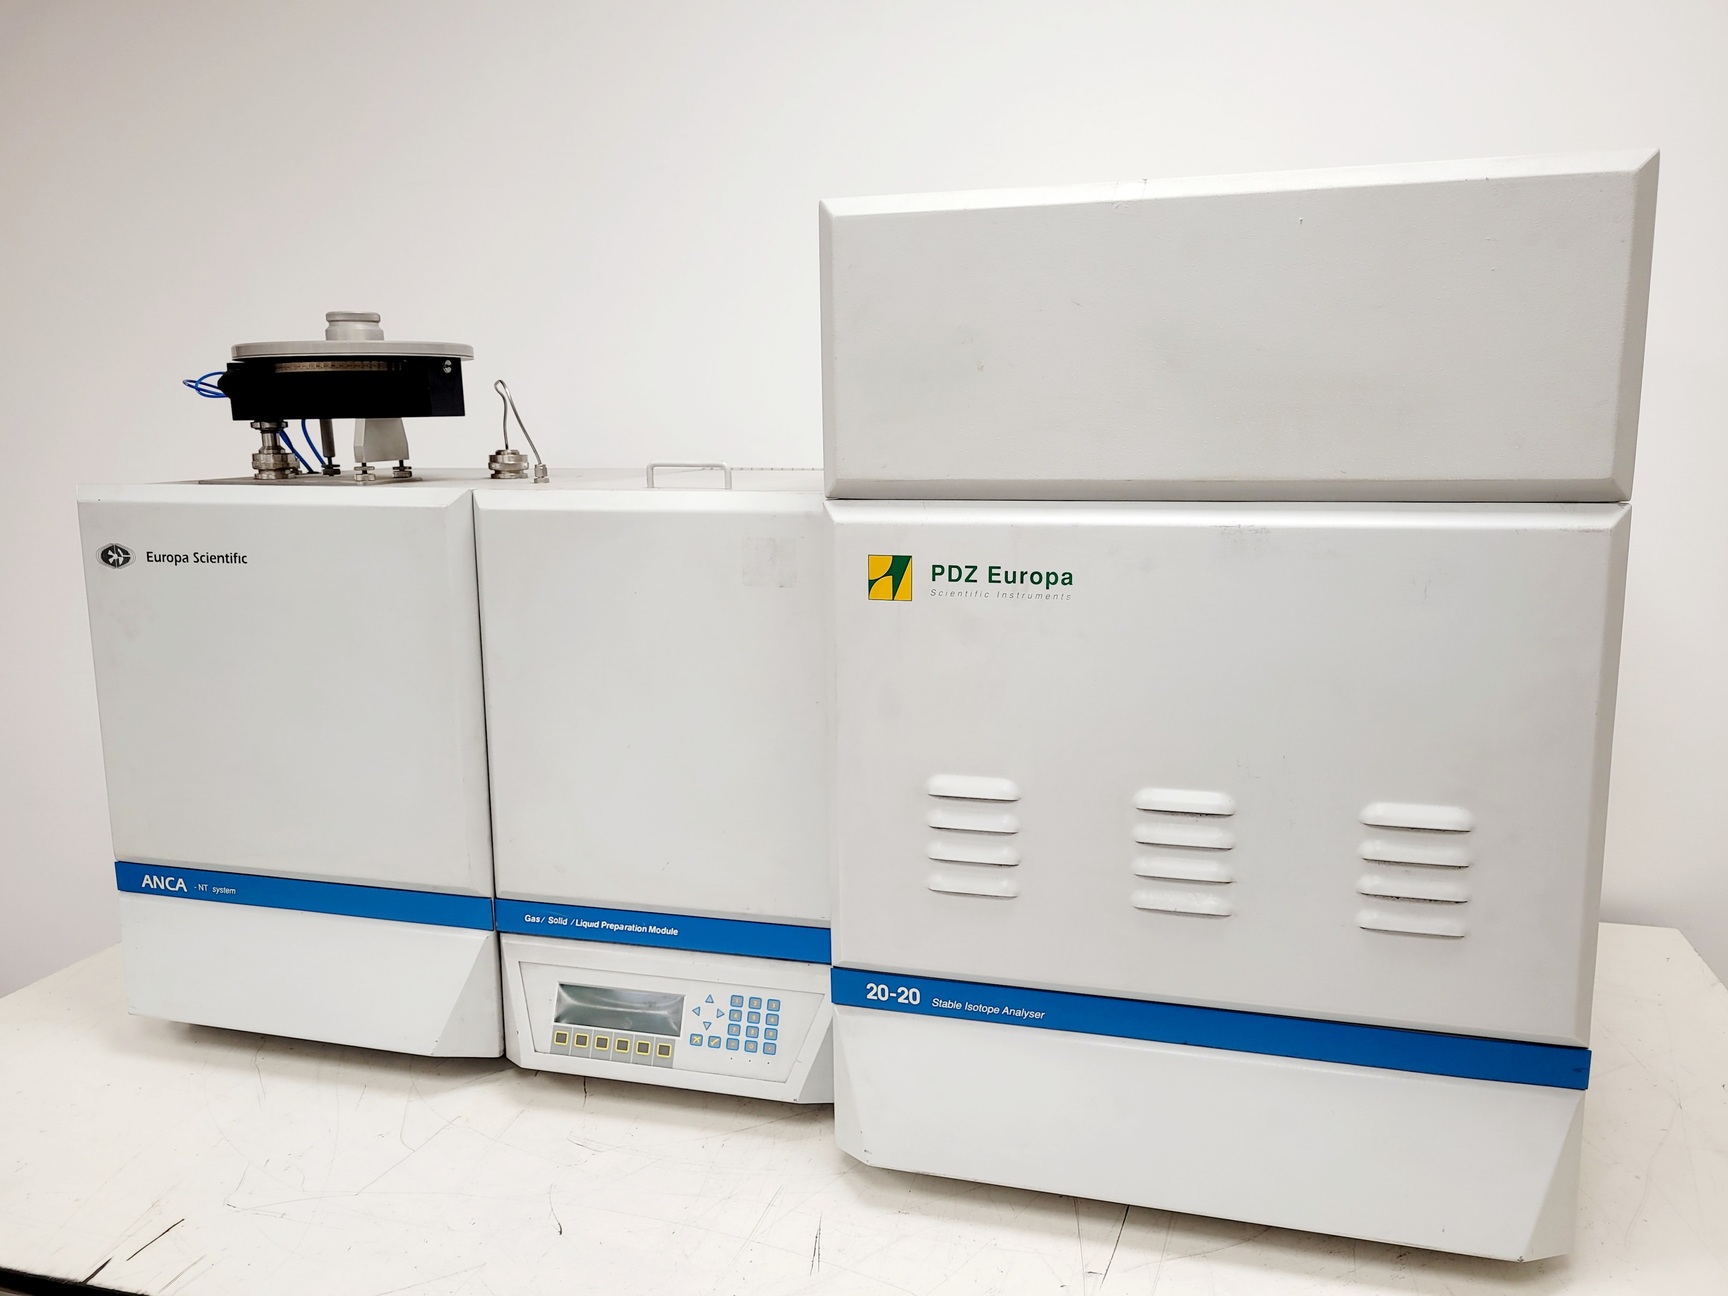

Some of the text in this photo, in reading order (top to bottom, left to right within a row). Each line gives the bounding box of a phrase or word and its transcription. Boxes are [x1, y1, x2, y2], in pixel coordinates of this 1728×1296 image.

[146, 551, 248, 566] Europa Scientific
[931, 564, 1074, 590] PDZ Europa
[930, 588, 1072, 601] Scientific Instruments
[141, 874, 188, 892] ANCA
[212, 885, 236, 895] system
[548, 916, 568, 926] Solid
[600, 921, 647, 934] Preparation
[649, 925, 679, 936] Module
[866, 983, 921, 1005] 20-20
[931, 997, 1046, 1020] Stable Isotope Analyser
